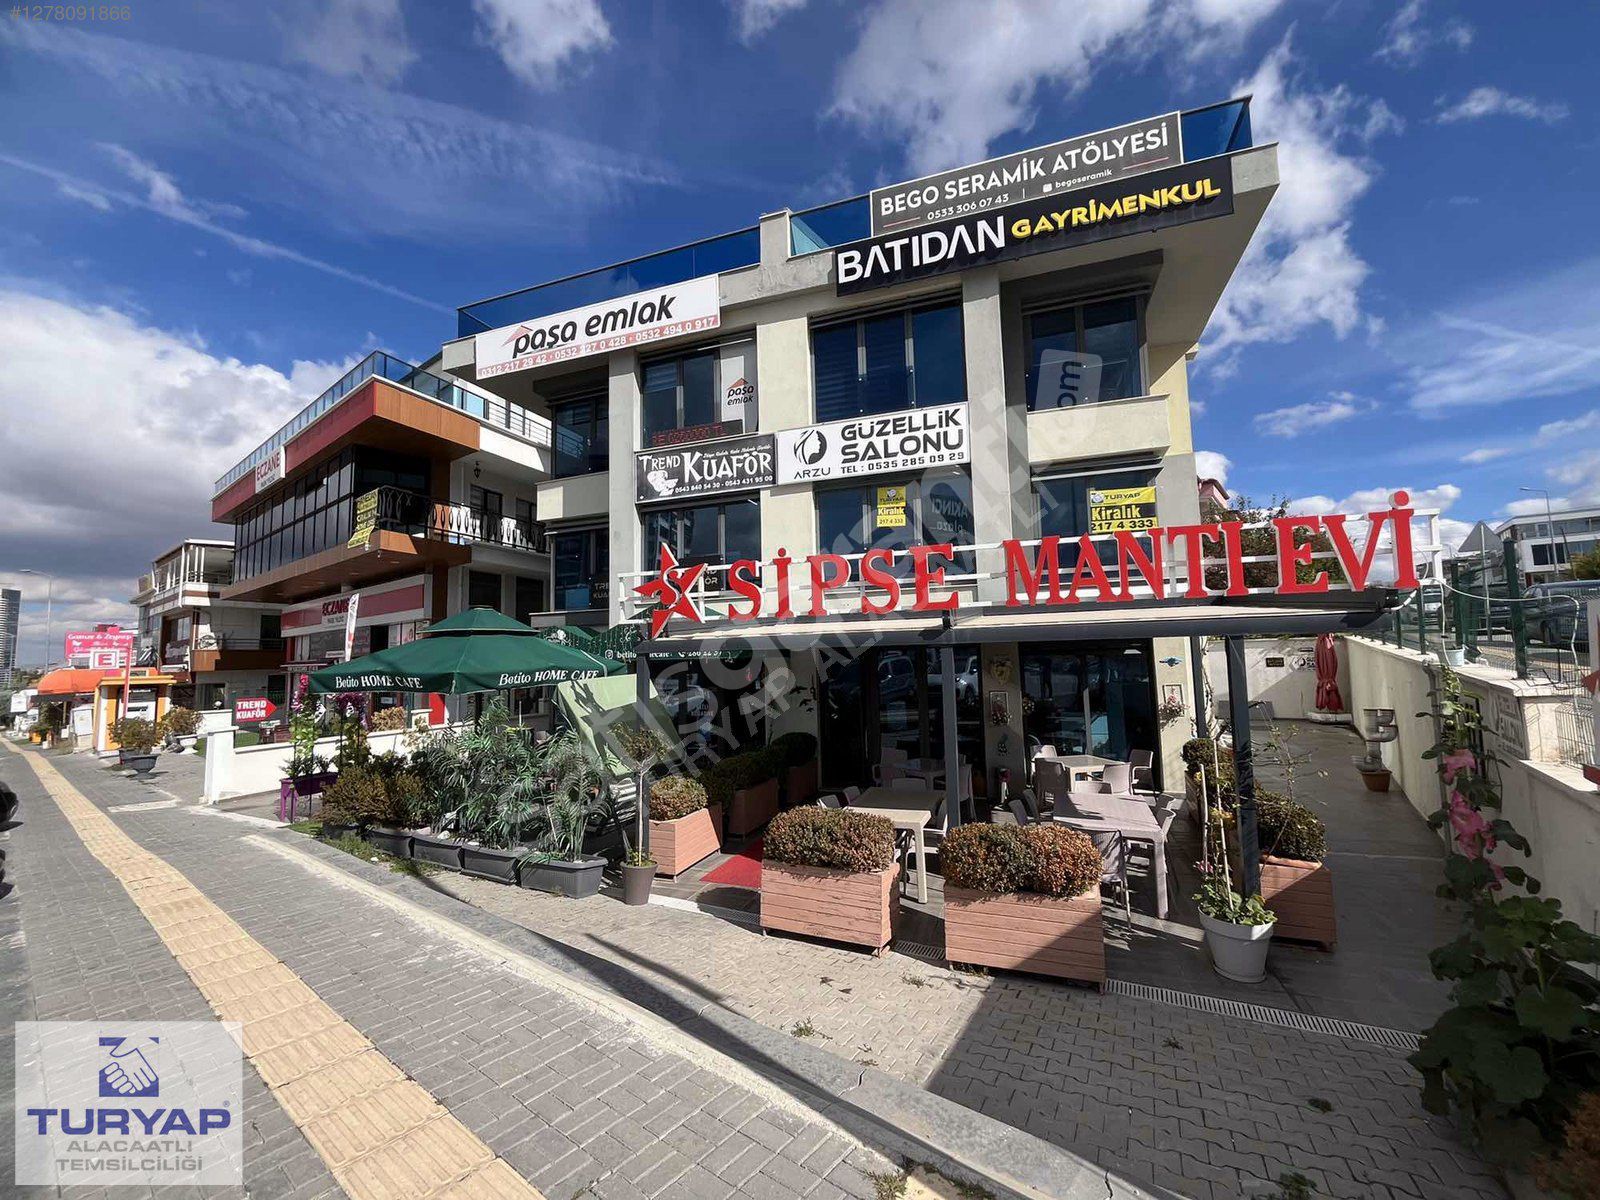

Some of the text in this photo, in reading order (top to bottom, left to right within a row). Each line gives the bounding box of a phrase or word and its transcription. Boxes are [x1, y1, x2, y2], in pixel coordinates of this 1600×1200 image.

[880, 122, 1169, 217] BEGO SERAMİK ATÖLYESİ
[1055, 169, 1113, 189] begoseramik
[927, 193, 1009, 220] 0533 306 07 43
[1011, 177, 1222, 239] GAYRİMENKUL
[836, 215, 1006, 284] BATIDAN
[585, 295, 677, 336] emlak
[481, 365, 502, 376] 0312
[503, 360, 520, 372] 217
[523, 358, 535, 368] 29
[536, 354, 548, 365] 42
[554, 349, 577, 360] 0532
[599, 340, 606, 349] 0
[607, 336, 627, 347] 428
[635, 329, 661, 342] 0532
[663, 325, 682, 337] 494
[685, 323, 692, 333] 0
[695, 317, 716, 330] 917
[841, 429, 964, 464] SALONU
[256, 452, 280, 481] ECZANE
[638, 455, 681, 472] TREND
[793, 467, 831, 480] ARZU
[841, 452, 965, 474] TEL 0535 285 09 29
[1104, 492, 1141, 500] TURYAP
[1091, 519, 1154, 531] 217 4 333
[728, 490, 1420, 621] SİPSE MANTI EVİ
[335, 675, 423, 689] Betito HOME CAFE
[498, 670, 600, 686] Betito HOME CAFE
[236, 700, 267, 710] TREND
[236, 709, 266, 719] KUAFÖR
